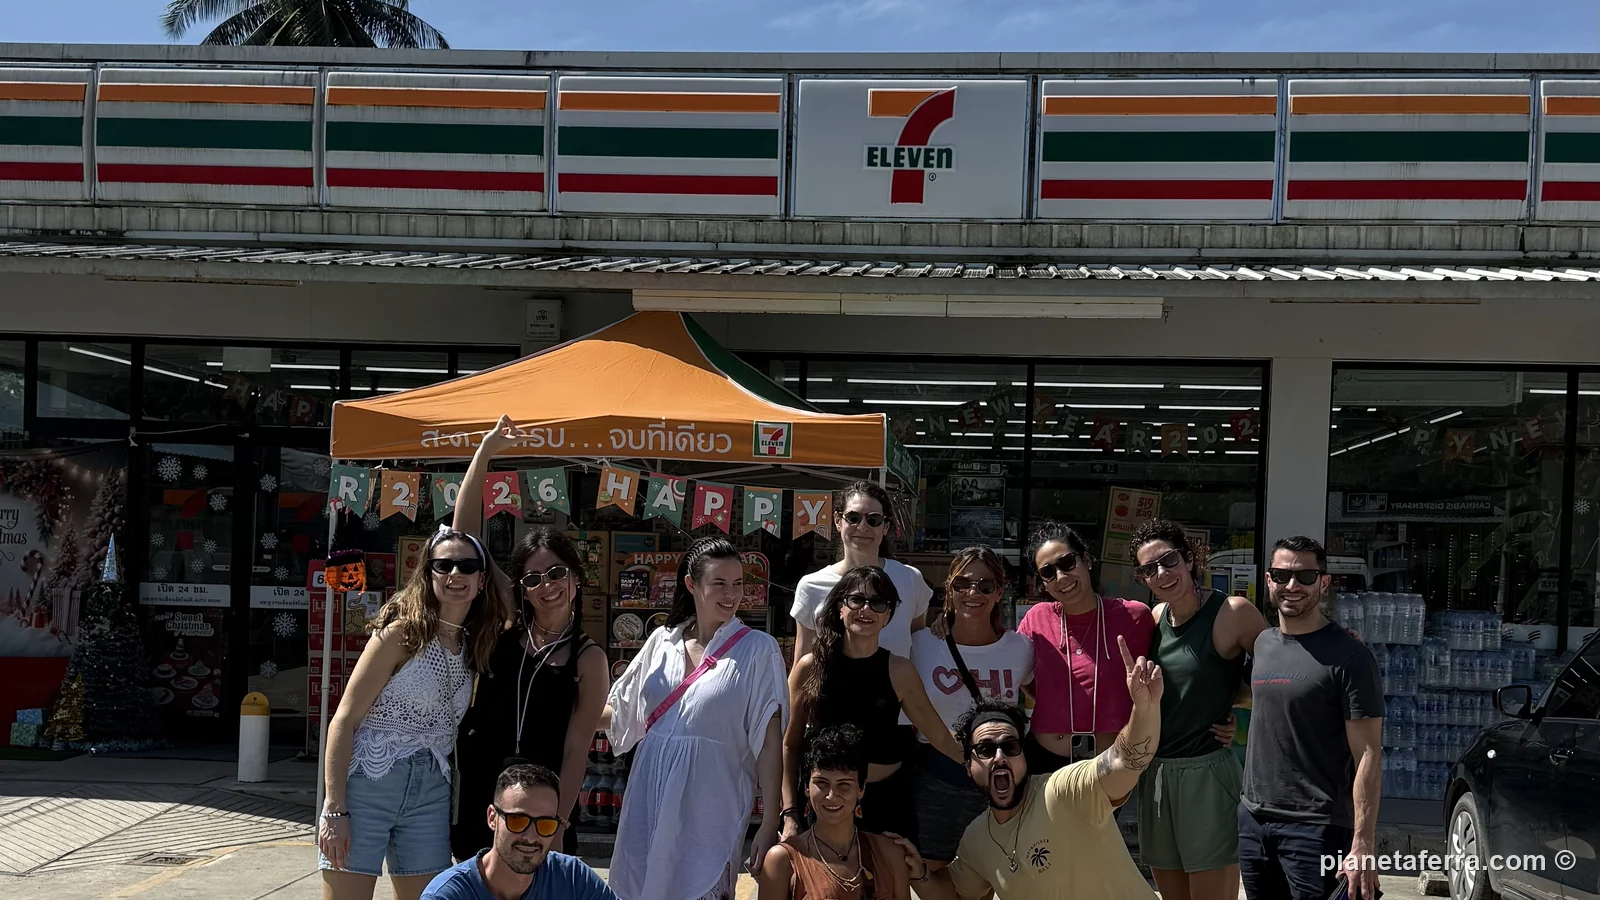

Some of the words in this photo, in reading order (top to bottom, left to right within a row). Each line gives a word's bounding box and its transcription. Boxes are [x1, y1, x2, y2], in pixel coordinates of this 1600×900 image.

[867, 86, 956, 204] 7
[762, 427, 784, 456] 7
[606, 472, 826, 525] HAPPY
[633, 553, 682, 565] HAPPY
[166, 621, 210, 631] Christmas
